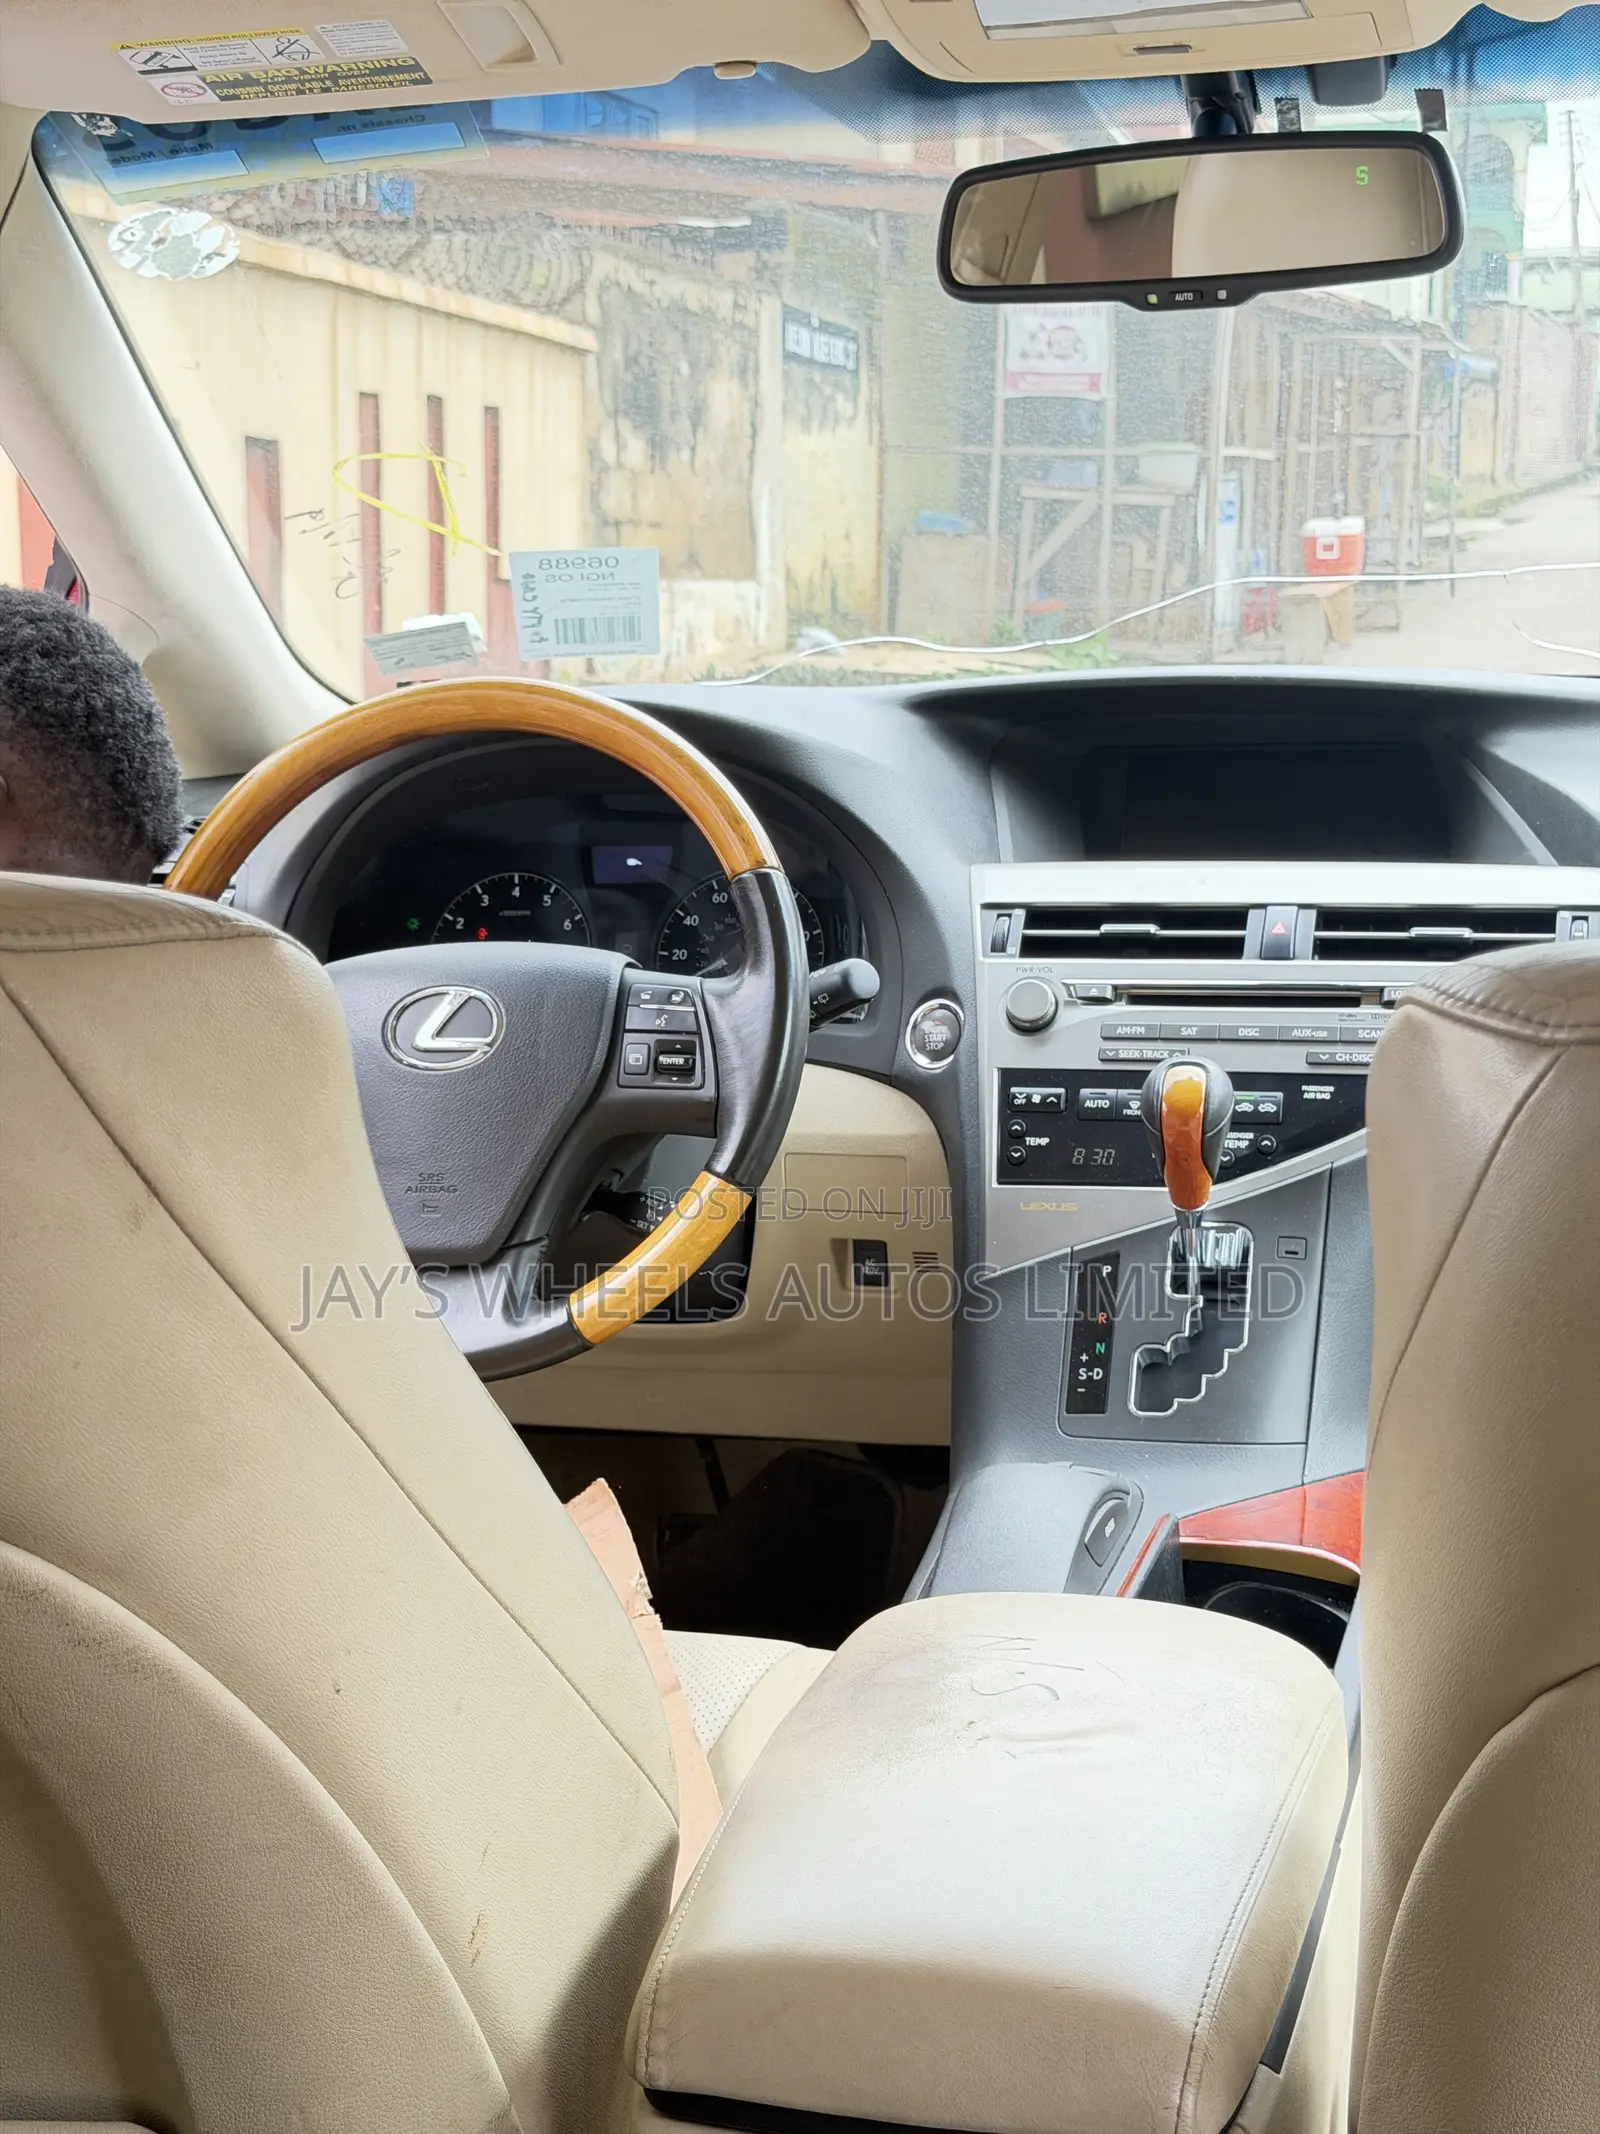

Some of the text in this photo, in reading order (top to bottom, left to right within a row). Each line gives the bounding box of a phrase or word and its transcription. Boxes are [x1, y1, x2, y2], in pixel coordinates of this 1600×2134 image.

[204, 57, 416, 83] AIR BAG WARNING
[291, 73, 329, 81] VISOR
[336, 69, 370, 77] OVER
[215, 85, 265, 97] COUSSIN
[338, 71, 427, 87] AVERTISSEMENT
[331, 80, 414, 93] PARESOLEIL
[1174, 292, 1194, 302] AUTO
[511, 886, 521, 898] 4
[711, 892, 729, 904] 60
[480, 894, 490, 907] 3
[542, 894, 552, 907] 5
[455, 917, 465, 930] 2
[563, 918, 573, 931] 6
[683, 914, 700, 927] 40
[671, 949, 688, 961] 20
[1180, 1026, 1197, 1036] SAT
[1238, 1027, 1260, 1037] DISC
[923, 1033, 947, 1043] START
[925, 1042, 945, 1051] STOP
[662, 1056, 685, 1066] ENTER
[1013, 1098, 1026, 1106] OFF
[1303, 1092, 1331, 1100] AIR BAG
[1084, 1099, 1110, 1109] AUTO
[1122, 1108, 1141, 1116] FRON
[1025, 1136, 1050, 1147] TEMP
[418, 1172, 445, 1182] SRS
[404, 1185, 458, 1195] AIRBAG
[1020, 1201, 1078, 1211] LEXUS
[1102, 1265, 1113, 1277] P
[1098, 1312, 1107, 1325] R
[1095, 1341, 1106, 1355] N
